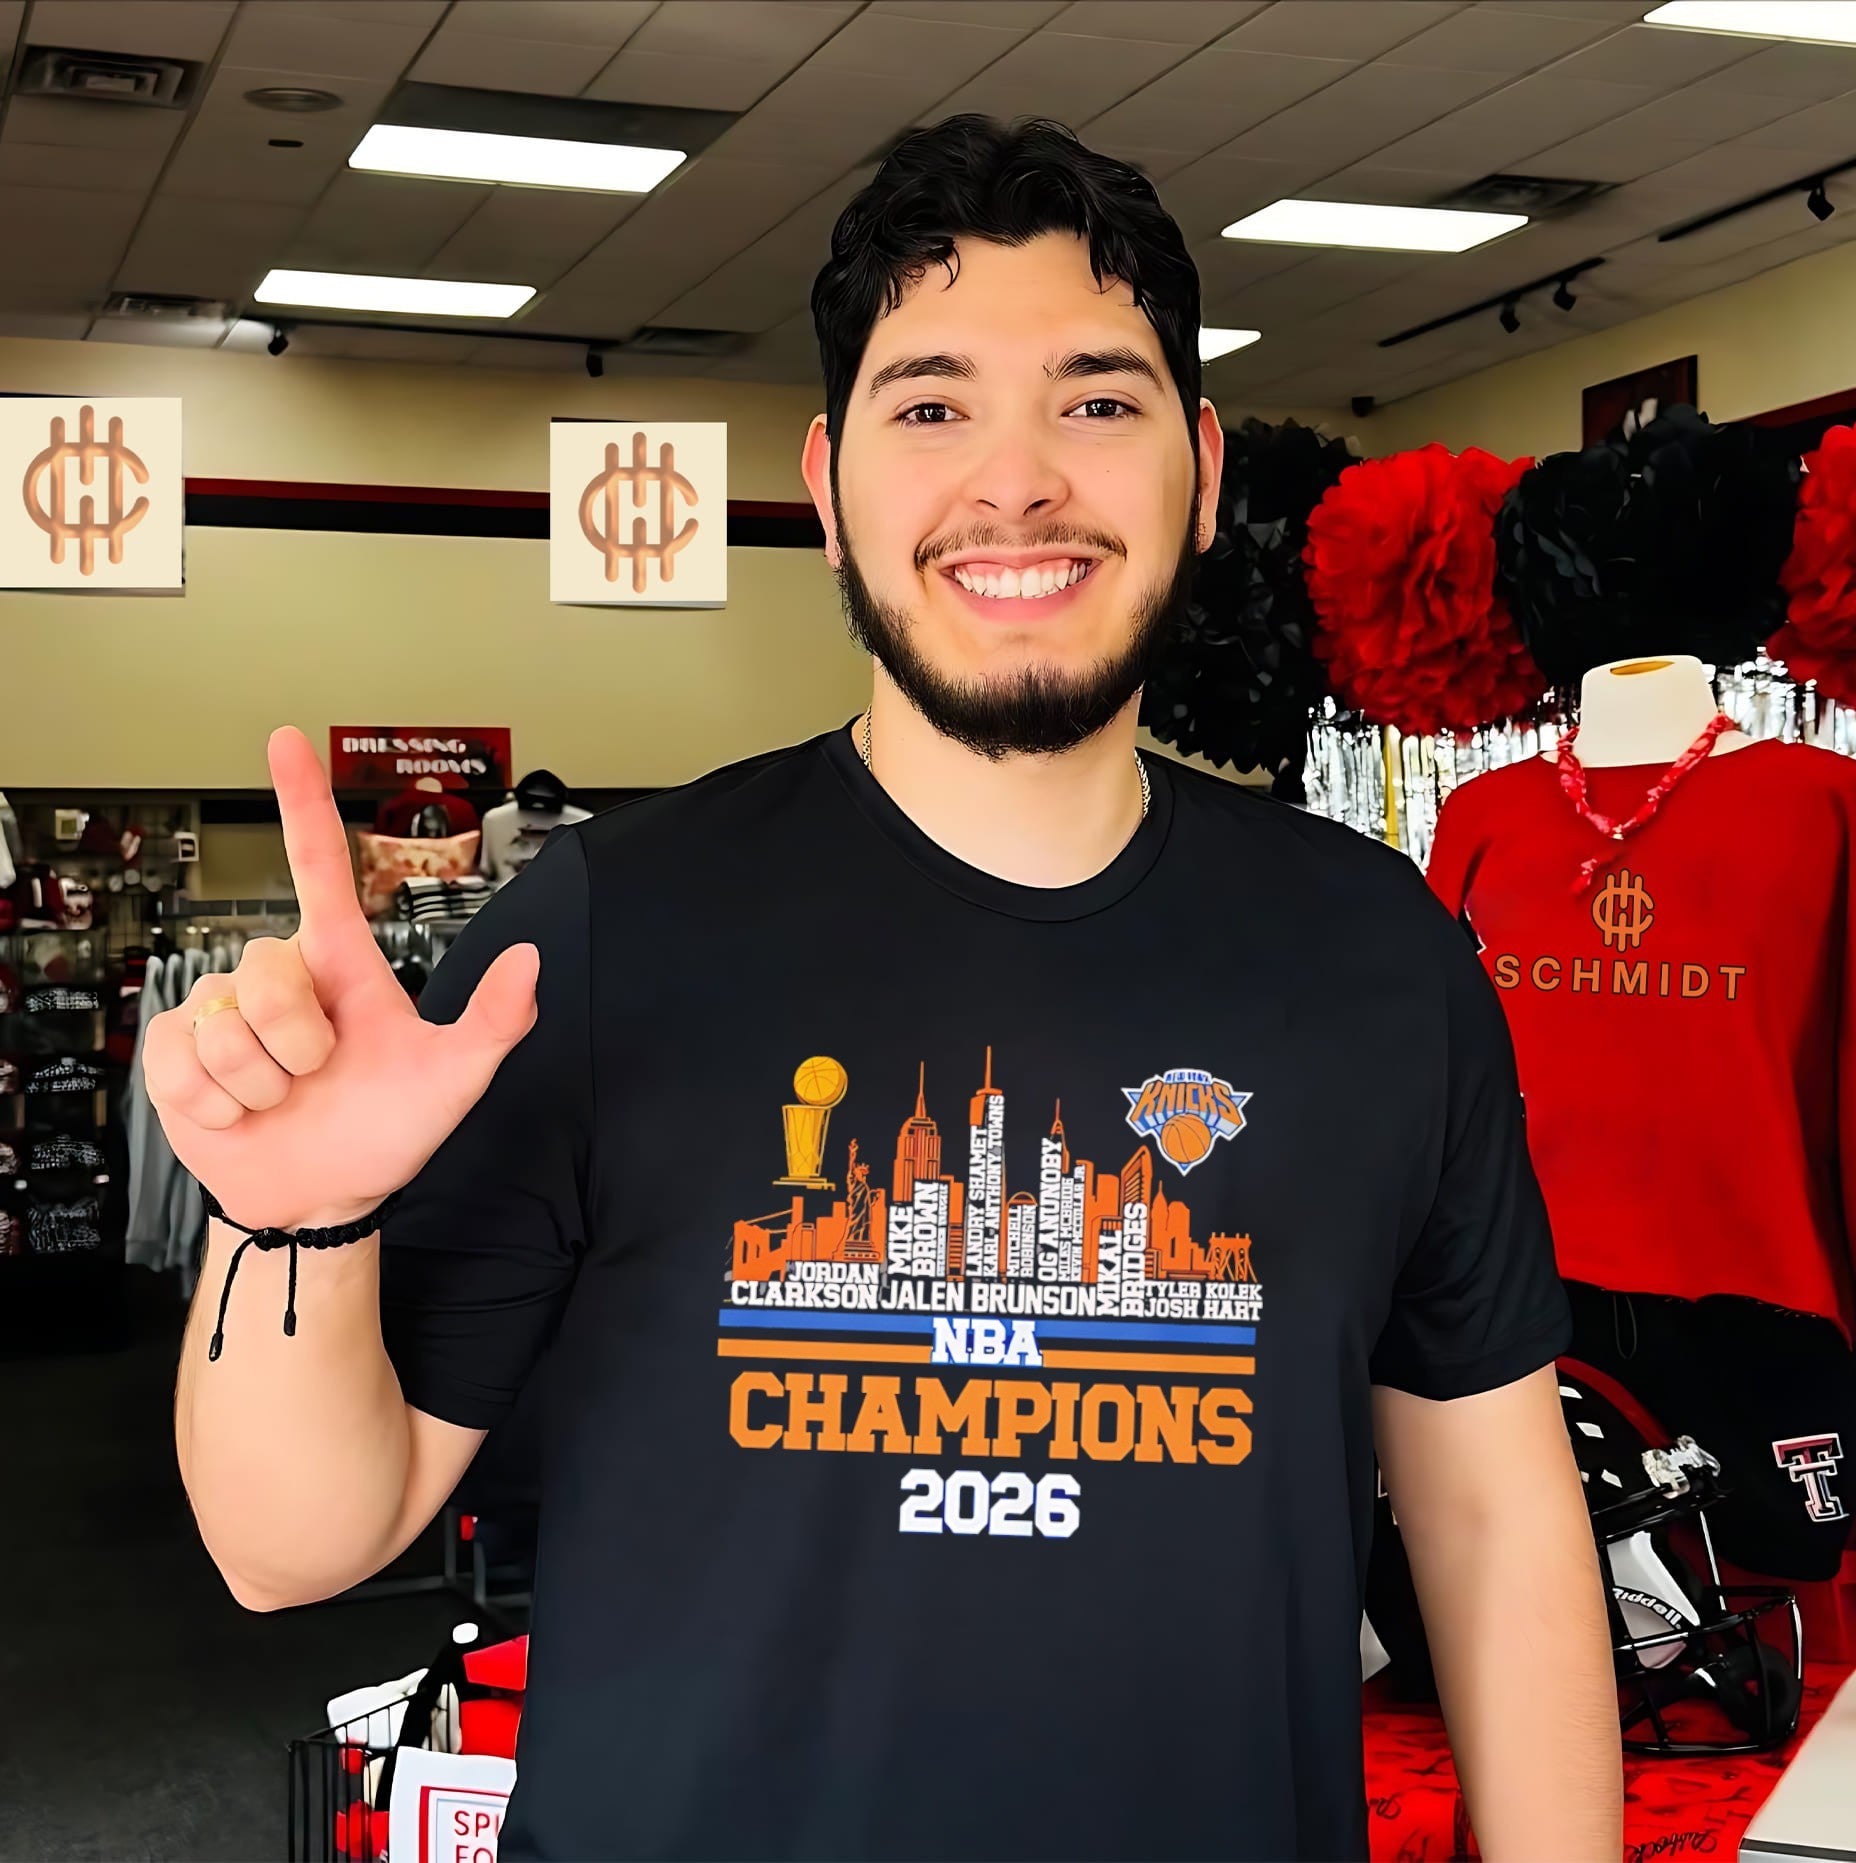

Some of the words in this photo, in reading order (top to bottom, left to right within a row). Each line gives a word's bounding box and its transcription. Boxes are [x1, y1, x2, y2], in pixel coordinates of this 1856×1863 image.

[396, 758, 487, 774] ROOMS
[1494, 953, 1748, 1001] SCHMIDT
[988, 1095, 1005, 1149] TOWNS
[1130, 1080, 1243, 1127] KNICKS
[968, 1125, 988, 1201] SHAMET
[1038, 1137, 1062, 1249] ANUNOBY
[888, 1205, 914, 1276] MIKE
[911, 1181, 939, 1277] BROWN
[966, 1203, 985, 1277] LANDRY
[1006, 1204, 1022, 1278] MITCHELL
[1020, 1204, 1037, 1278] ROBINSON
[788, 1261, 880, 1285] JORDAN
[1037, 1251, 1059, 1282] OG
[1097, 1228, 1122, 1317] MIKAL
[1120, 1202, 1148, 1318] BRIDGES
[730, 1280, 879, 1310] CLARKSON
[881, 1279, 965, 1313] JALEN
[970, 1280, 1097, 1317] BRUNSON
[1144, 1298, 1200, 1319] JOSH
[1202, 1299, 1263, 1321] HART
[1145, 1281, 1201, 1299] TYLER
[1205, 1283, 1263, 1301] KOLEK
[931, 1317, 1043, 1367] NBA
[729, 1371, 1254, 1466] CHAMPIONS
[899, 1469, 1081, 1538] 2026
